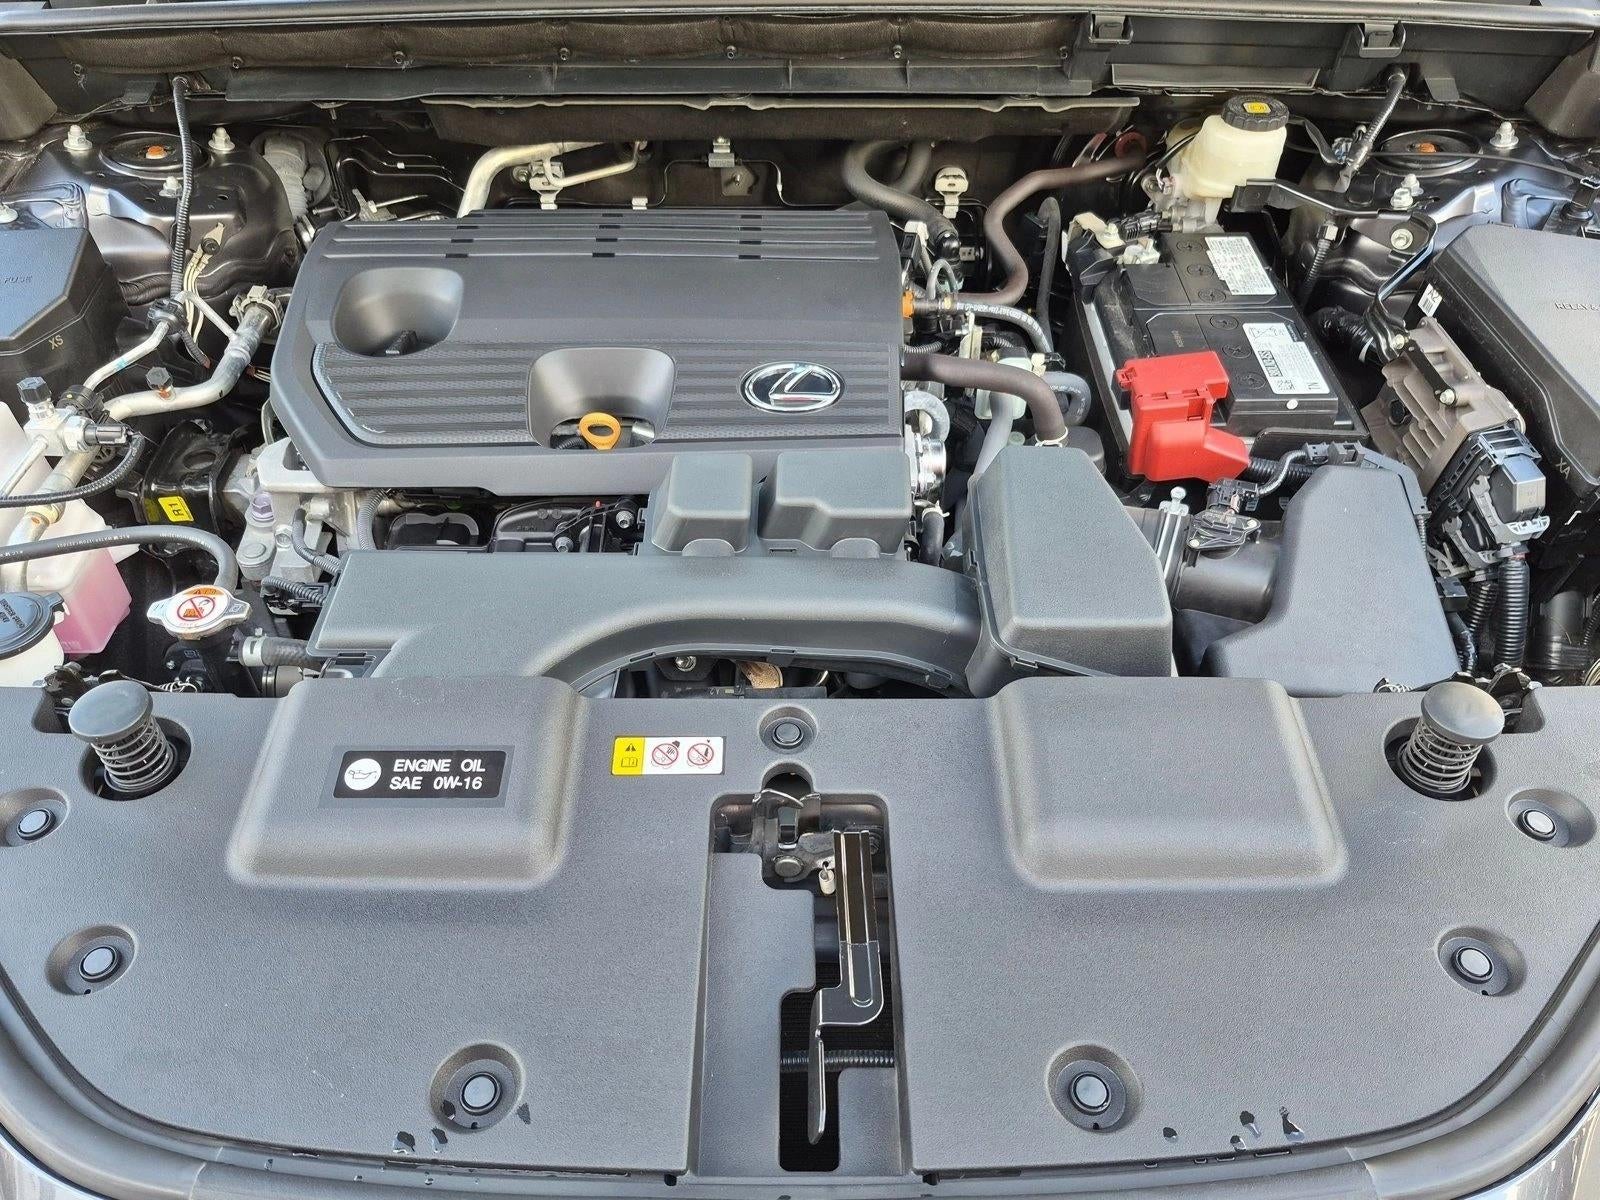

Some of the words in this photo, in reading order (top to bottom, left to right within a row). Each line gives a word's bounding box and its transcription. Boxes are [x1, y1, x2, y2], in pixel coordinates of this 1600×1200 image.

[48, 334, 64, 350] XS
[1555, 457, 1570, 480] XA
[393, 758, 451, 772] ENGINE
[460, 758, 486, 772] OIL
[389, 776, 423, 790] SAE
[433, 776, 483, 790] 0W-16
